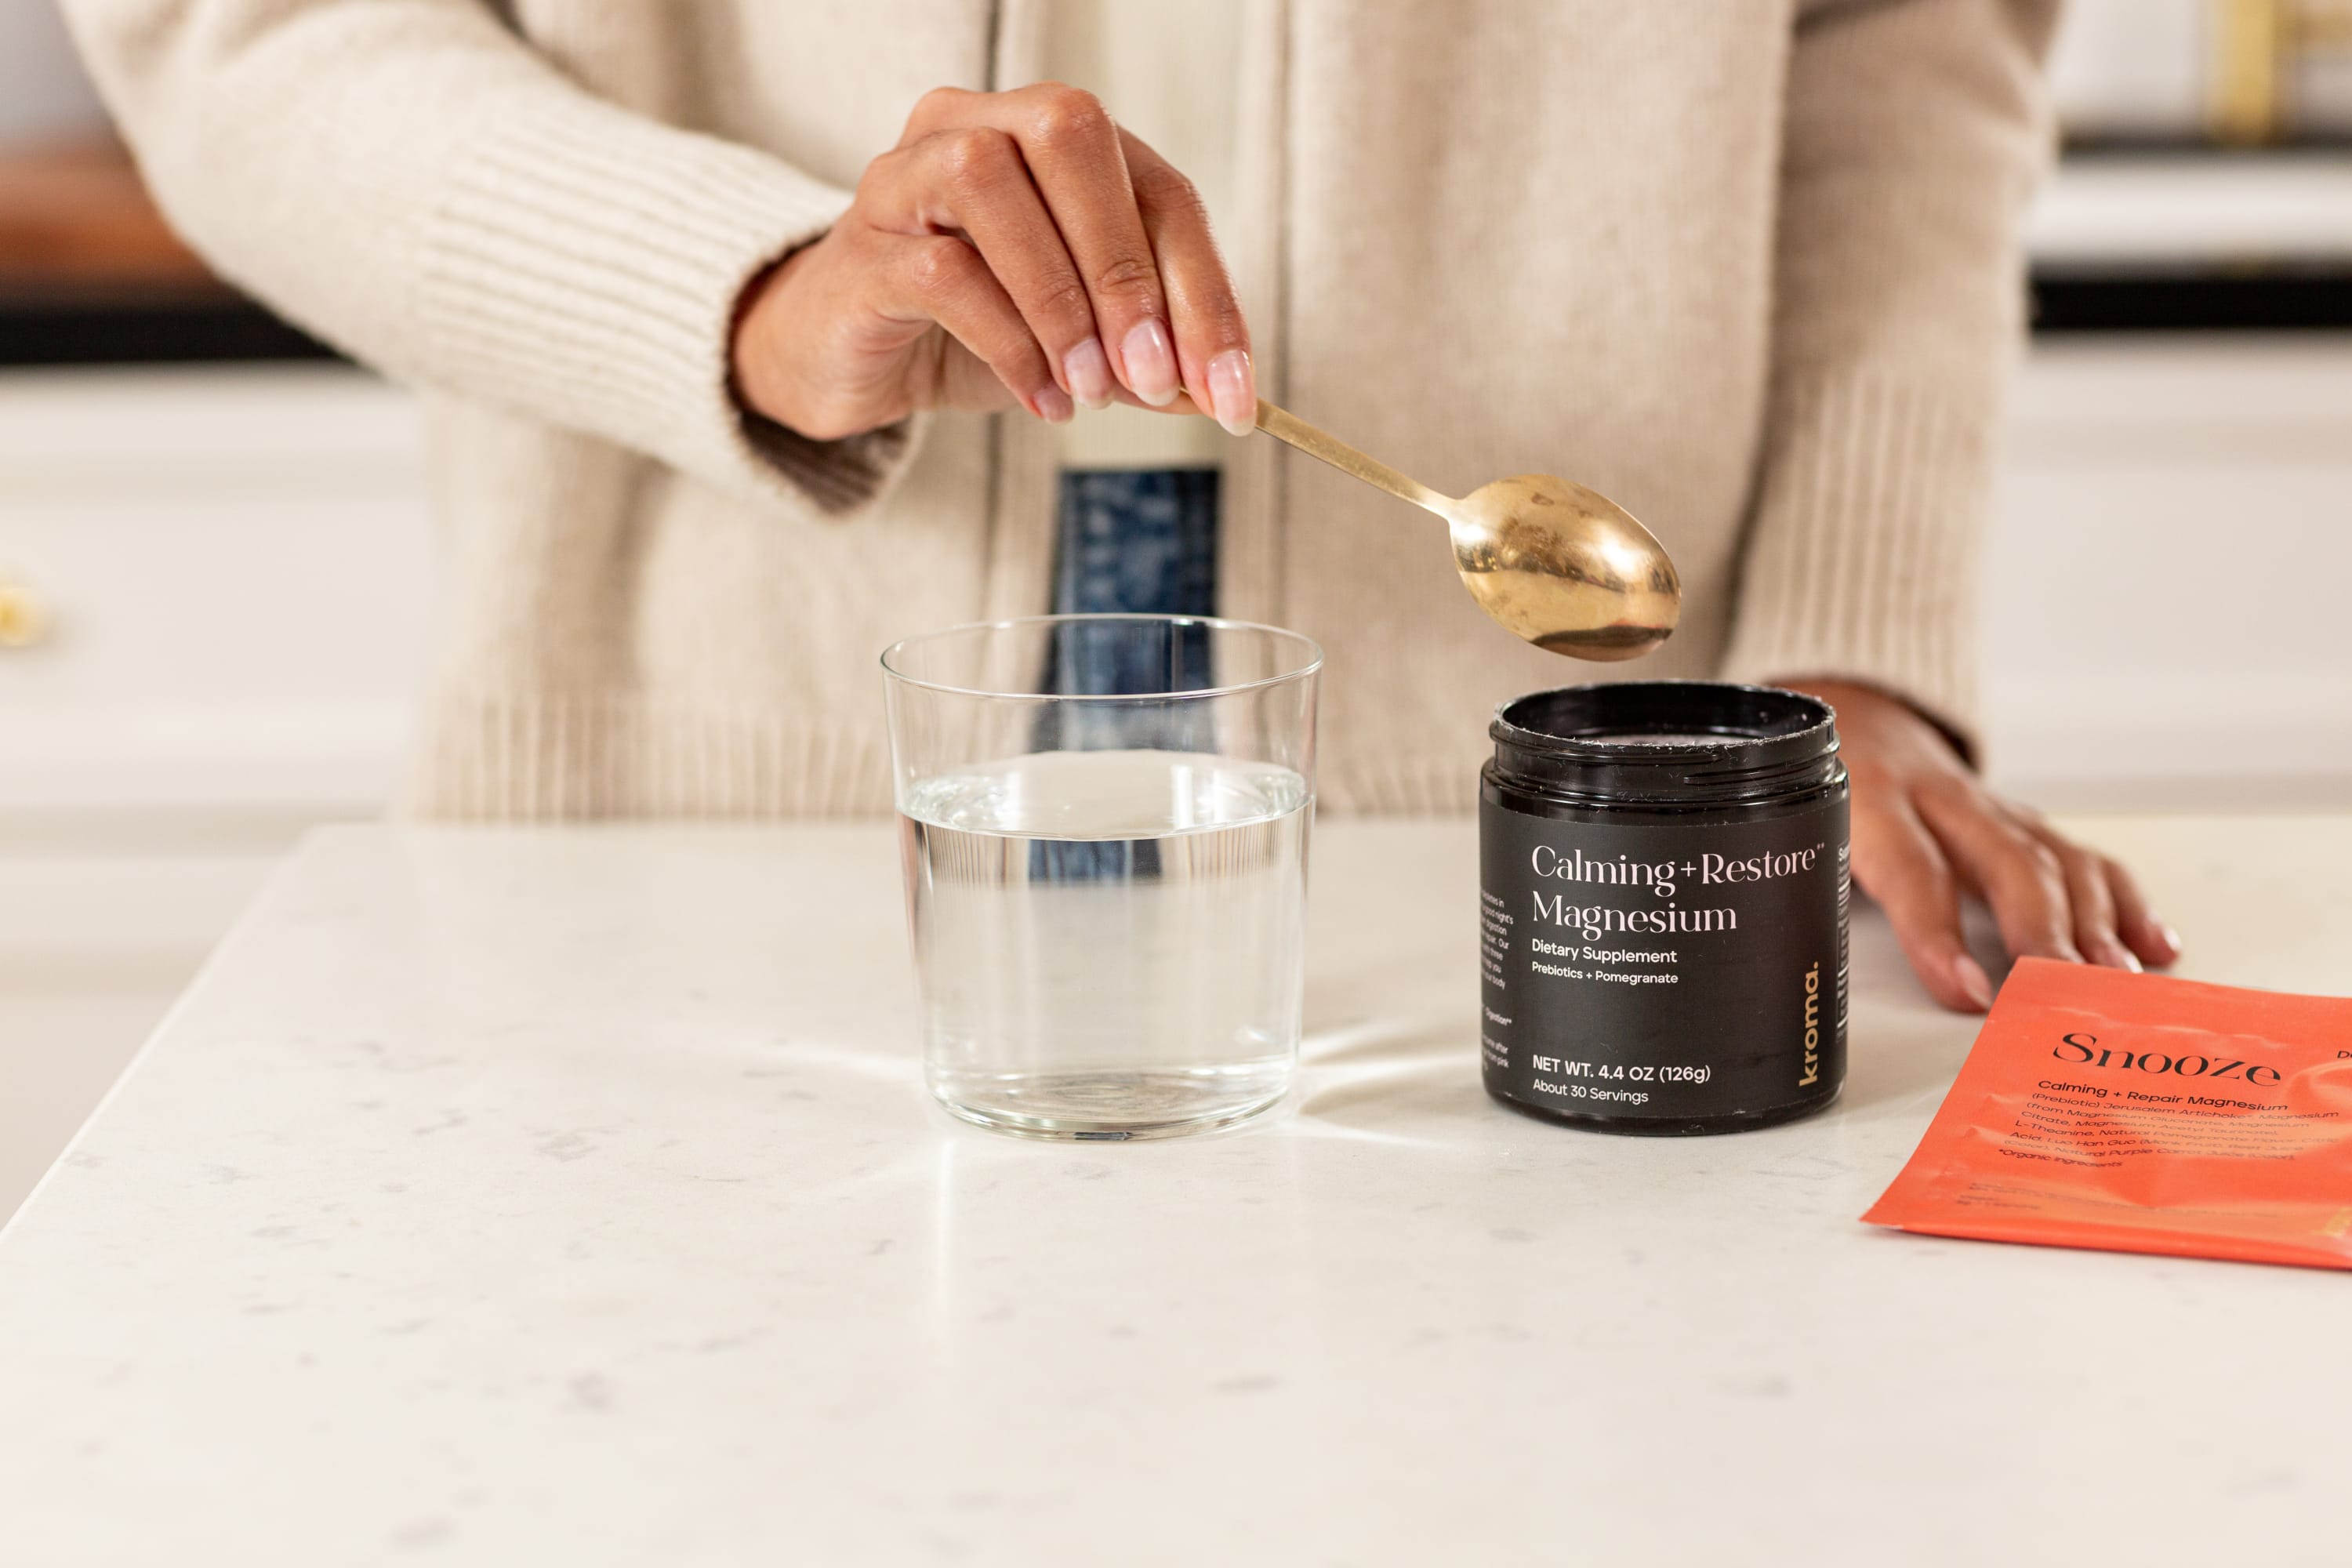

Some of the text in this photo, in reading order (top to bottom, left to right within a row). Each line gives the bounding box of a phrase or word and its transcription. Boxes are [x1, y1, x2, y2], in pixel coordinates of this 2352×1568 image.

[1531, 891, 1738, 942] Magnesium
[1531, 938, 1678, 965] Dietary Supplement
[1531, 961, 1583, 980] Prebiotics
[1595, 971, 1679, 985] Pomegranate
[1799, 961, 1819, 1087] kroma.
[1533, 1054, 1711, 1082] NET WT. 4.4 OZ (126g)
[2052, 1033, 2281, 1087] Snooze
[1533, 1078, 1649, 1105] About 30 Servings
[2038, 1080, 2107, 1098] Calming
[2127, 1091, 2183, 1103] Repair
[2187, 1096, 2288, 1111] Magnesium
[2021, 1112, 2071, 1126] Citrate,
[2027, 1102, 2063, 1114] (from
[2067, 1109, 2147, 1120] Magnesium
[2032, 1093, 2100, 1108] (Prebiotic)
[2103, 1103, 2175, 1113] Jerusalem
[2259, 1112, 2339, 1121] Magnesium
[2015, 1120, 2095, 1136] L-Theanine,
[2109, 1148, 2153, 1157] Purple
